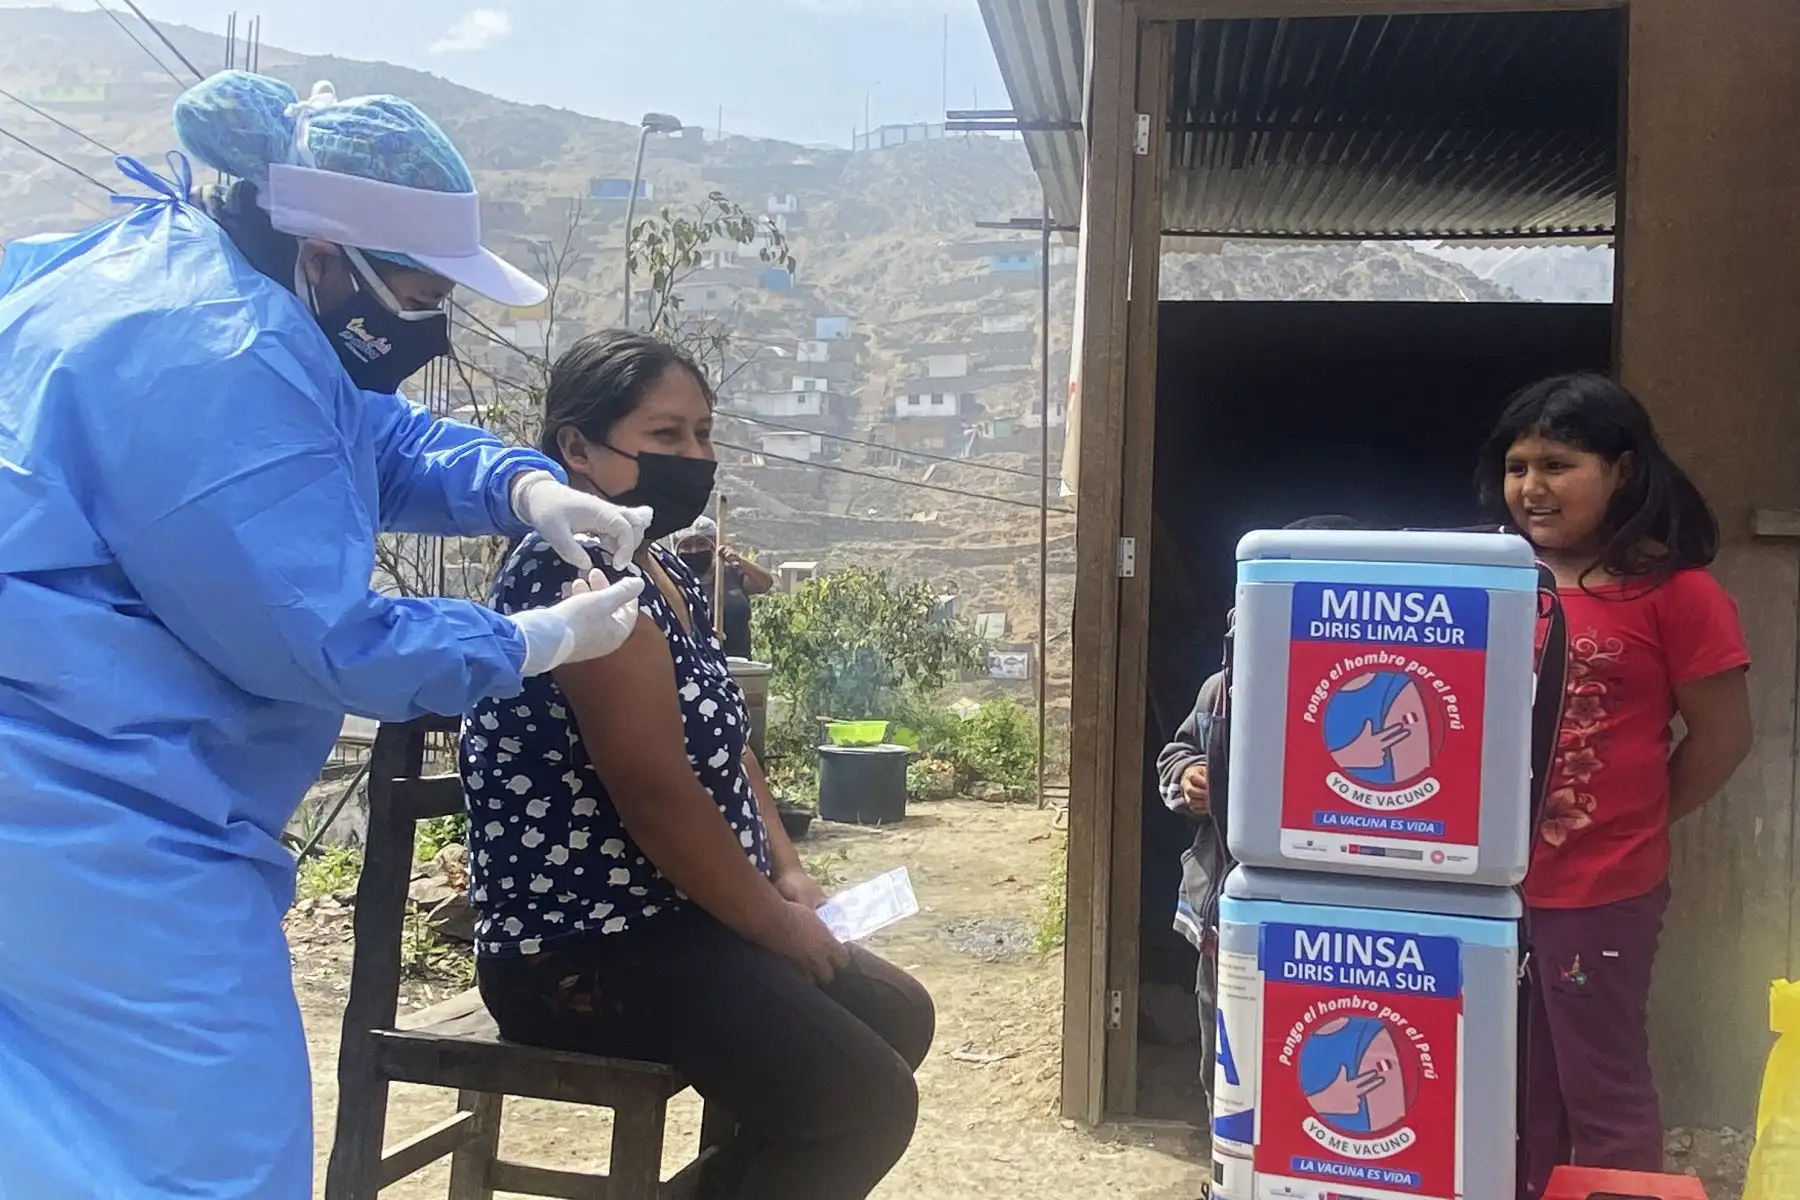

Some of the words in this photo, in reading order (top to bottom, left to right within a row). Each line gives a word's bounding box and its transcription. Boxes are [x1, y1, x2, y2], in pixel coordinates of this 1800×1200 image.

[1320, 589, 1453, 624] MINSA
[1310, 621, 1361, 640] DIRIS
[1367, 624, 1418, 643] LIMA
[1423, 627, 1465, 645] SUR
[1303, 679, 1330, 723] Pongo
[1330, 662, 1343, 681] el
[1344, 650, 1405, 671] hombro
[1405, 660, 1434, 681] por
[1433, 677, 1450, 693] el
[1443, 693, 1464, 730] Perú
[1331, 776, 1348, 795] YO
[1352, 792, 1372, 805] ME
[1376, 781, 1434, 807] VACUNO
[1323, 813, 1337, 825] LA
[1340, 815, 1387, 829] VACUNA
[1390, 819, 1404, 831] ES
[1407, 820, 1434, 833] VIDA
[1294, 930, 1424, 971] MINSA
[1283, 961, 1333, 982] DIRIS
[1339, 968, 1389, 988] LIMA
[1395, 973, 1436, 992] SUR
[1279, 1020, 1304, 1066] Pongo
[1304, 1006, 1315, 1023] el
[1318, 994, 1378, 1015] hombro
[1378, 1006, 1407, 1026] por
[1407, 1025, 1424, 1041] el
[1416, 1041, 1439, 1080] Perú
[1307, 1121, 1325, 1141] YO
[1329, 1137, 1349, 1152] ME
[1353, 1131, 1410, 1155] VACUNO
[1299, 1160, 1314, 1172] LA
[1317, 1161, 1365, 1179] VACUNA
[1367, 1168, 1382, 1180] ES
[1383, 1170, 1412, 1185] VIDA
